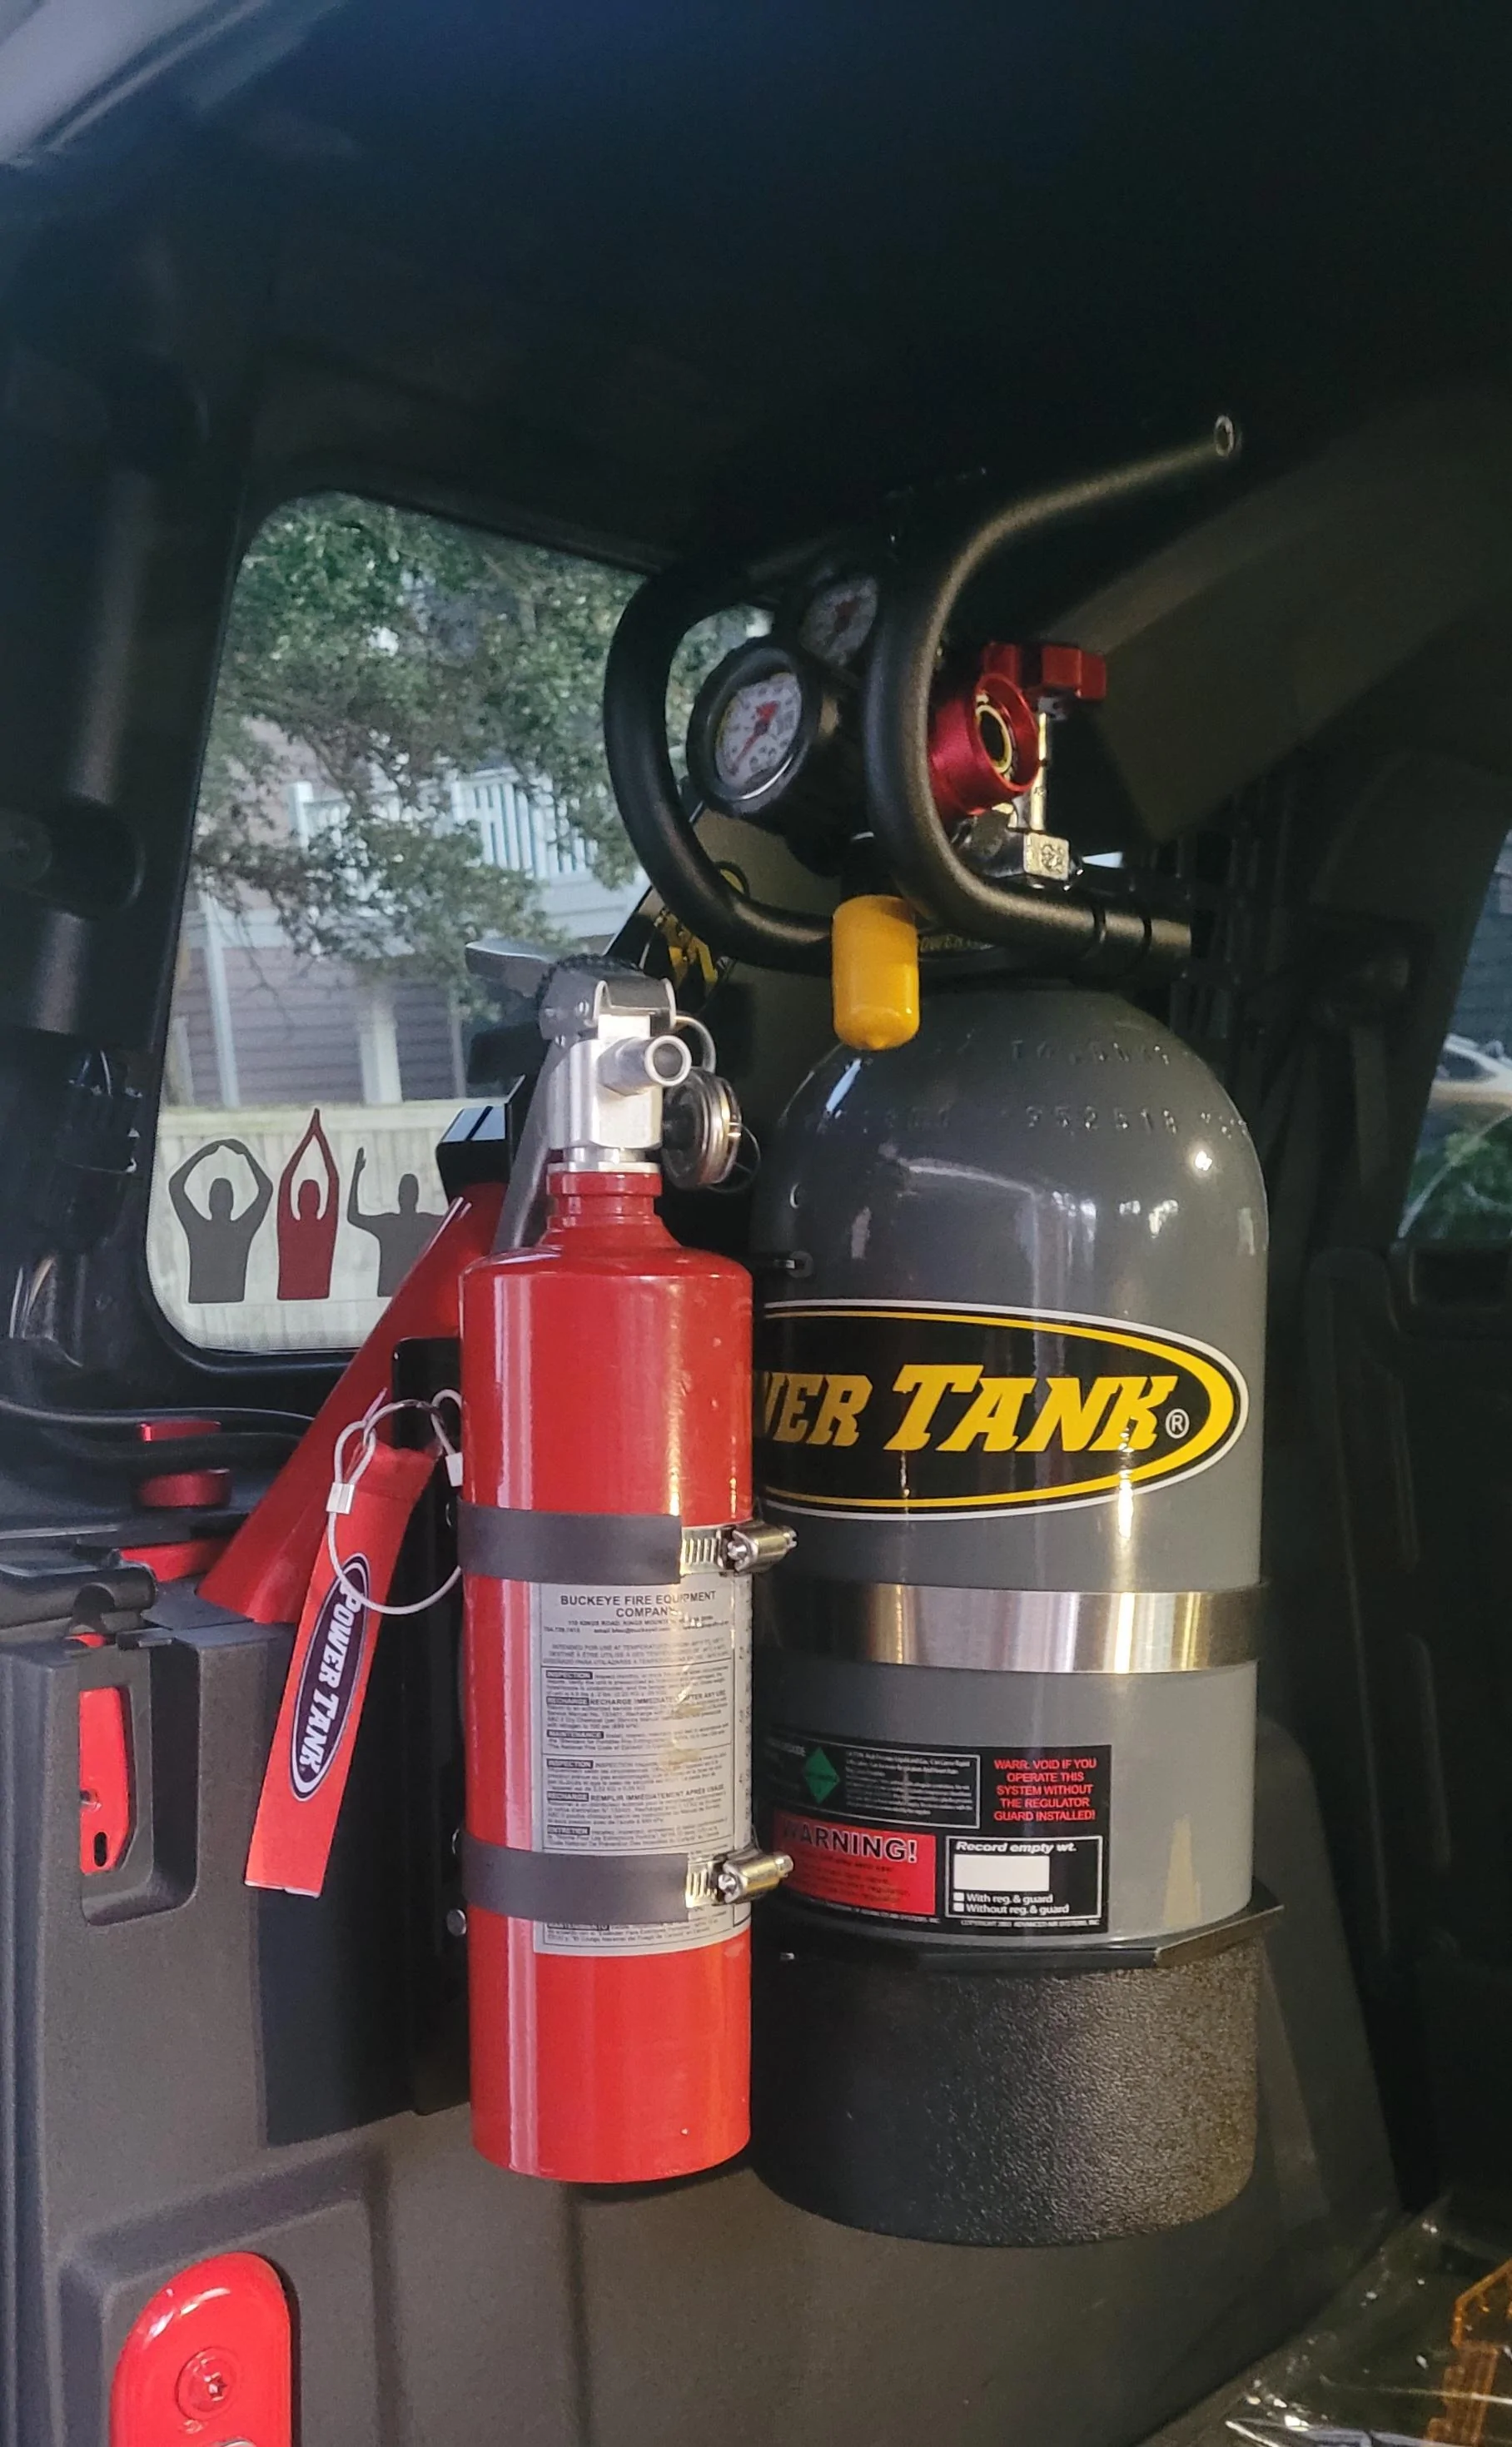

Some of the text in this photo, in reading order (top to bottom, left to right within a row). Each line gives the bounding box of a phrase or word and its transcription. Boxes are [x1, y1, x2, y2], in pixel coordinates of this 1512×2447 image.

[883, 1364, 1178, 1452] TANK
[560, 1594, 620, 1606] BUCKEYE
[624, 1594, 652, 1605] FIRE
[299, 1581, 362, 1774] POWER TANK
[547, 1671, 590, 1679] INSPECTION
[547, 1759, 591, 1768] INSPECTION
[993, 1758, 1097, 1770] WARR. VOID IF YOU
[1006, 1771, 1085, 1783] OPERATE THIS
[996, 1783, 1094, 1796] SYSTEM WITHOUT
[1000, 1797, 1090, 1808] THE REGULATOR
[993, 1808, 1097, 1821] GUARD INSTALLED!
[781, 1820, 918, 1864] WARNING!
[956, 1841, 1077, 1854] Record empty wt.
[966, 1892, 1054, 1905] With reg. & guard
[966, 1903, 1070, 1916] Without reg. & guard
